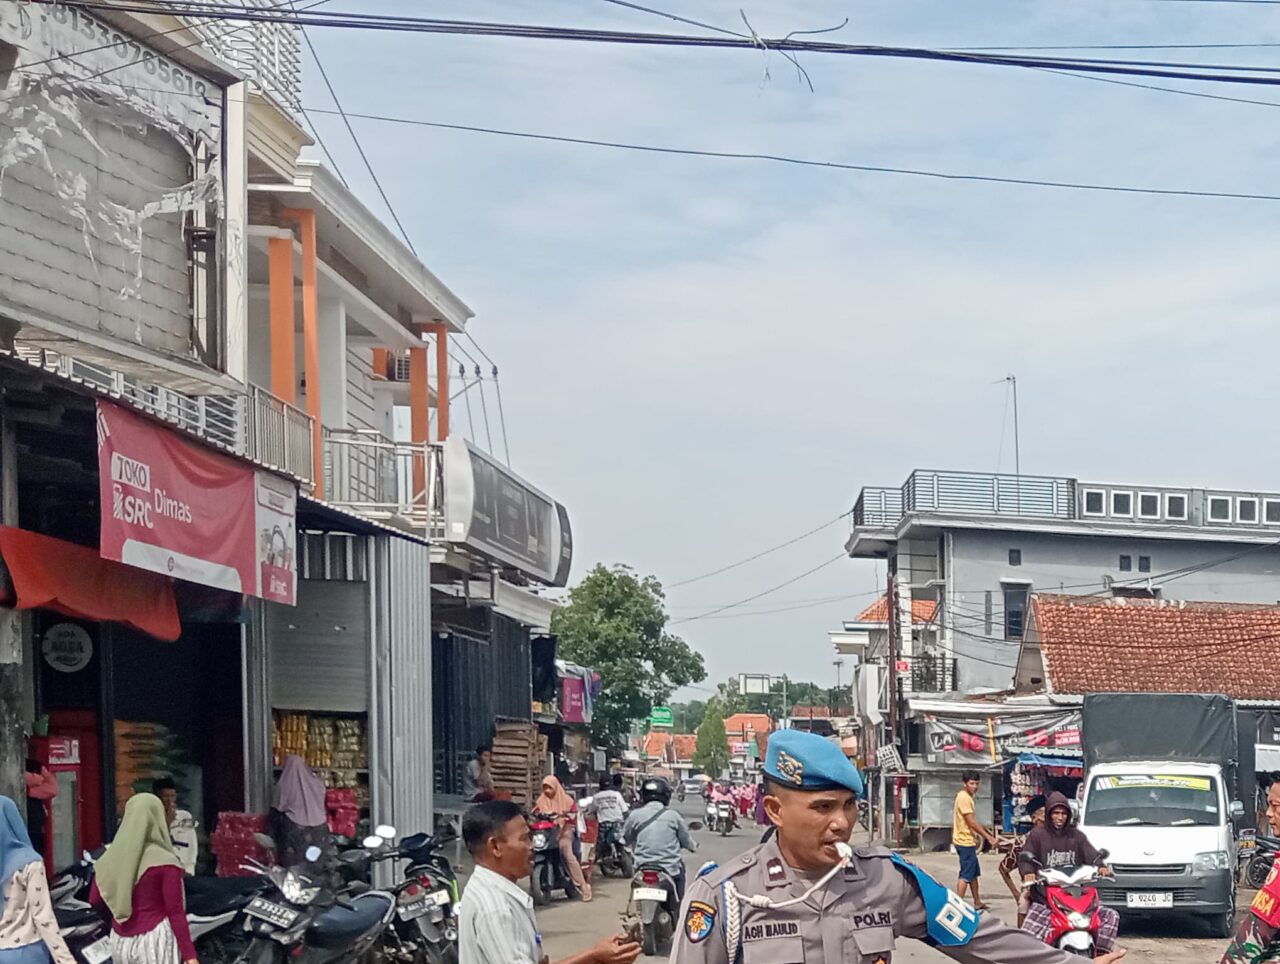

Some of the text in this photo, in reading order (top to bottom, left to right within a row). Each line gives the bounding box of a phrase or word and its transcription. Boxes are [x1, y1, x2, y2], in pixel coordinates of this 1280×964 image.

[117, 456, 148, 487] TOKO
[124, 495, 154, 529] SRC
[154, 488, 192, 524] Dimas
[960, 732, 985, 752] 16
[853, 911, 891, 928] POLRI
